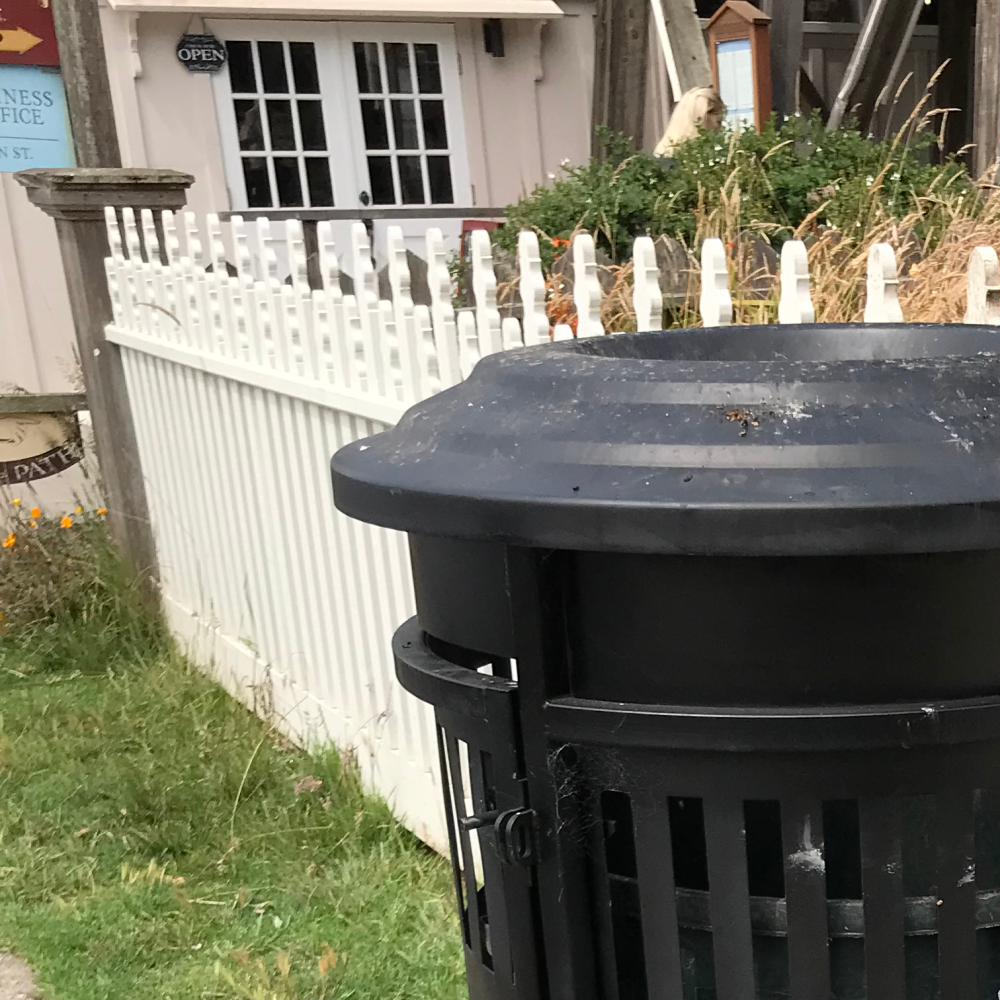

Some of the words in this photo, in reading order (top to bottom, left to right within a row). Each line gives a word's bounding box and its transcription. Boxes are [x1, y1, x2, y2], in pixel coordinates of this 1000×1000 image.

[178, 48, 225, 61] OPEN
[0, 88, 54, 108] NESS
[0, 107, 45, 126] FICE
[12, 146, 34, 160] ST.
